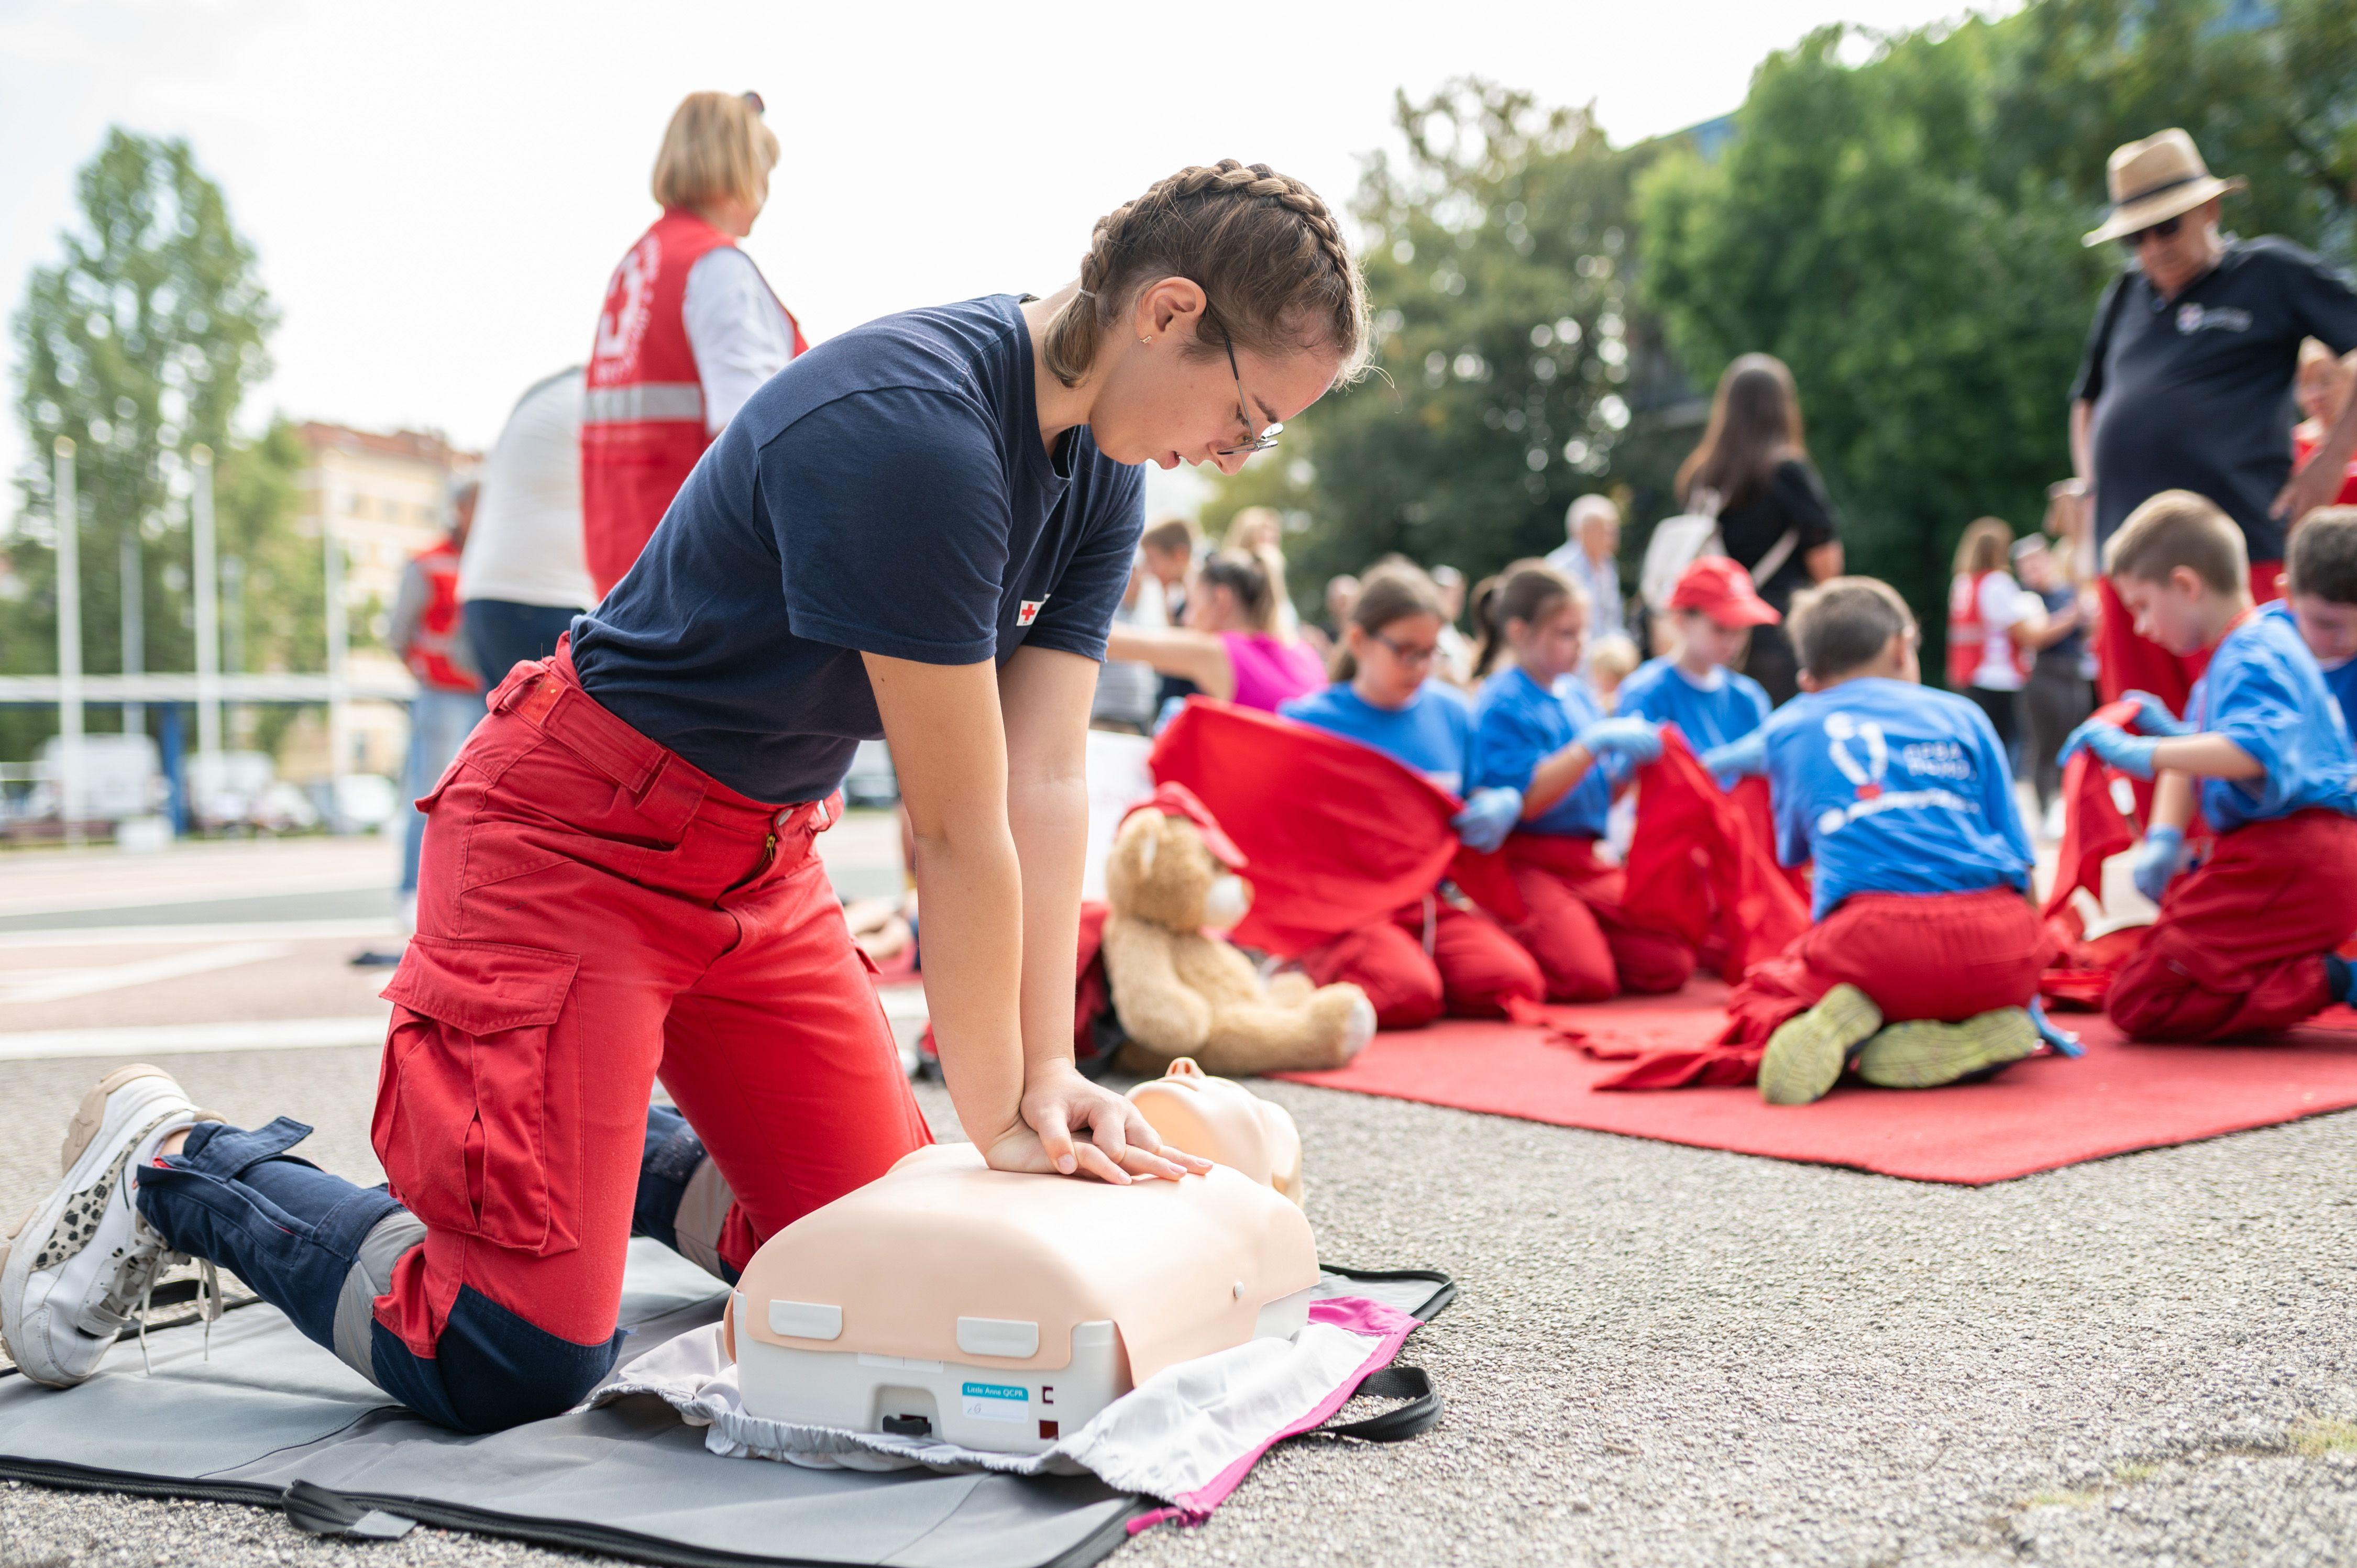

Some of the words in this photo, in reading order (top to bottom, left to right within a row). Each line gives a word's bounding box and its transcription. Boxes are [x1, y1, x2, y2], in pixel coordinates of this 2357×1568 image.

[967, 1385, 983, 1394] Little
[985, 1386, 1001, 1396] Anne
[1003, 1388, 1023, 1398] QCPR
